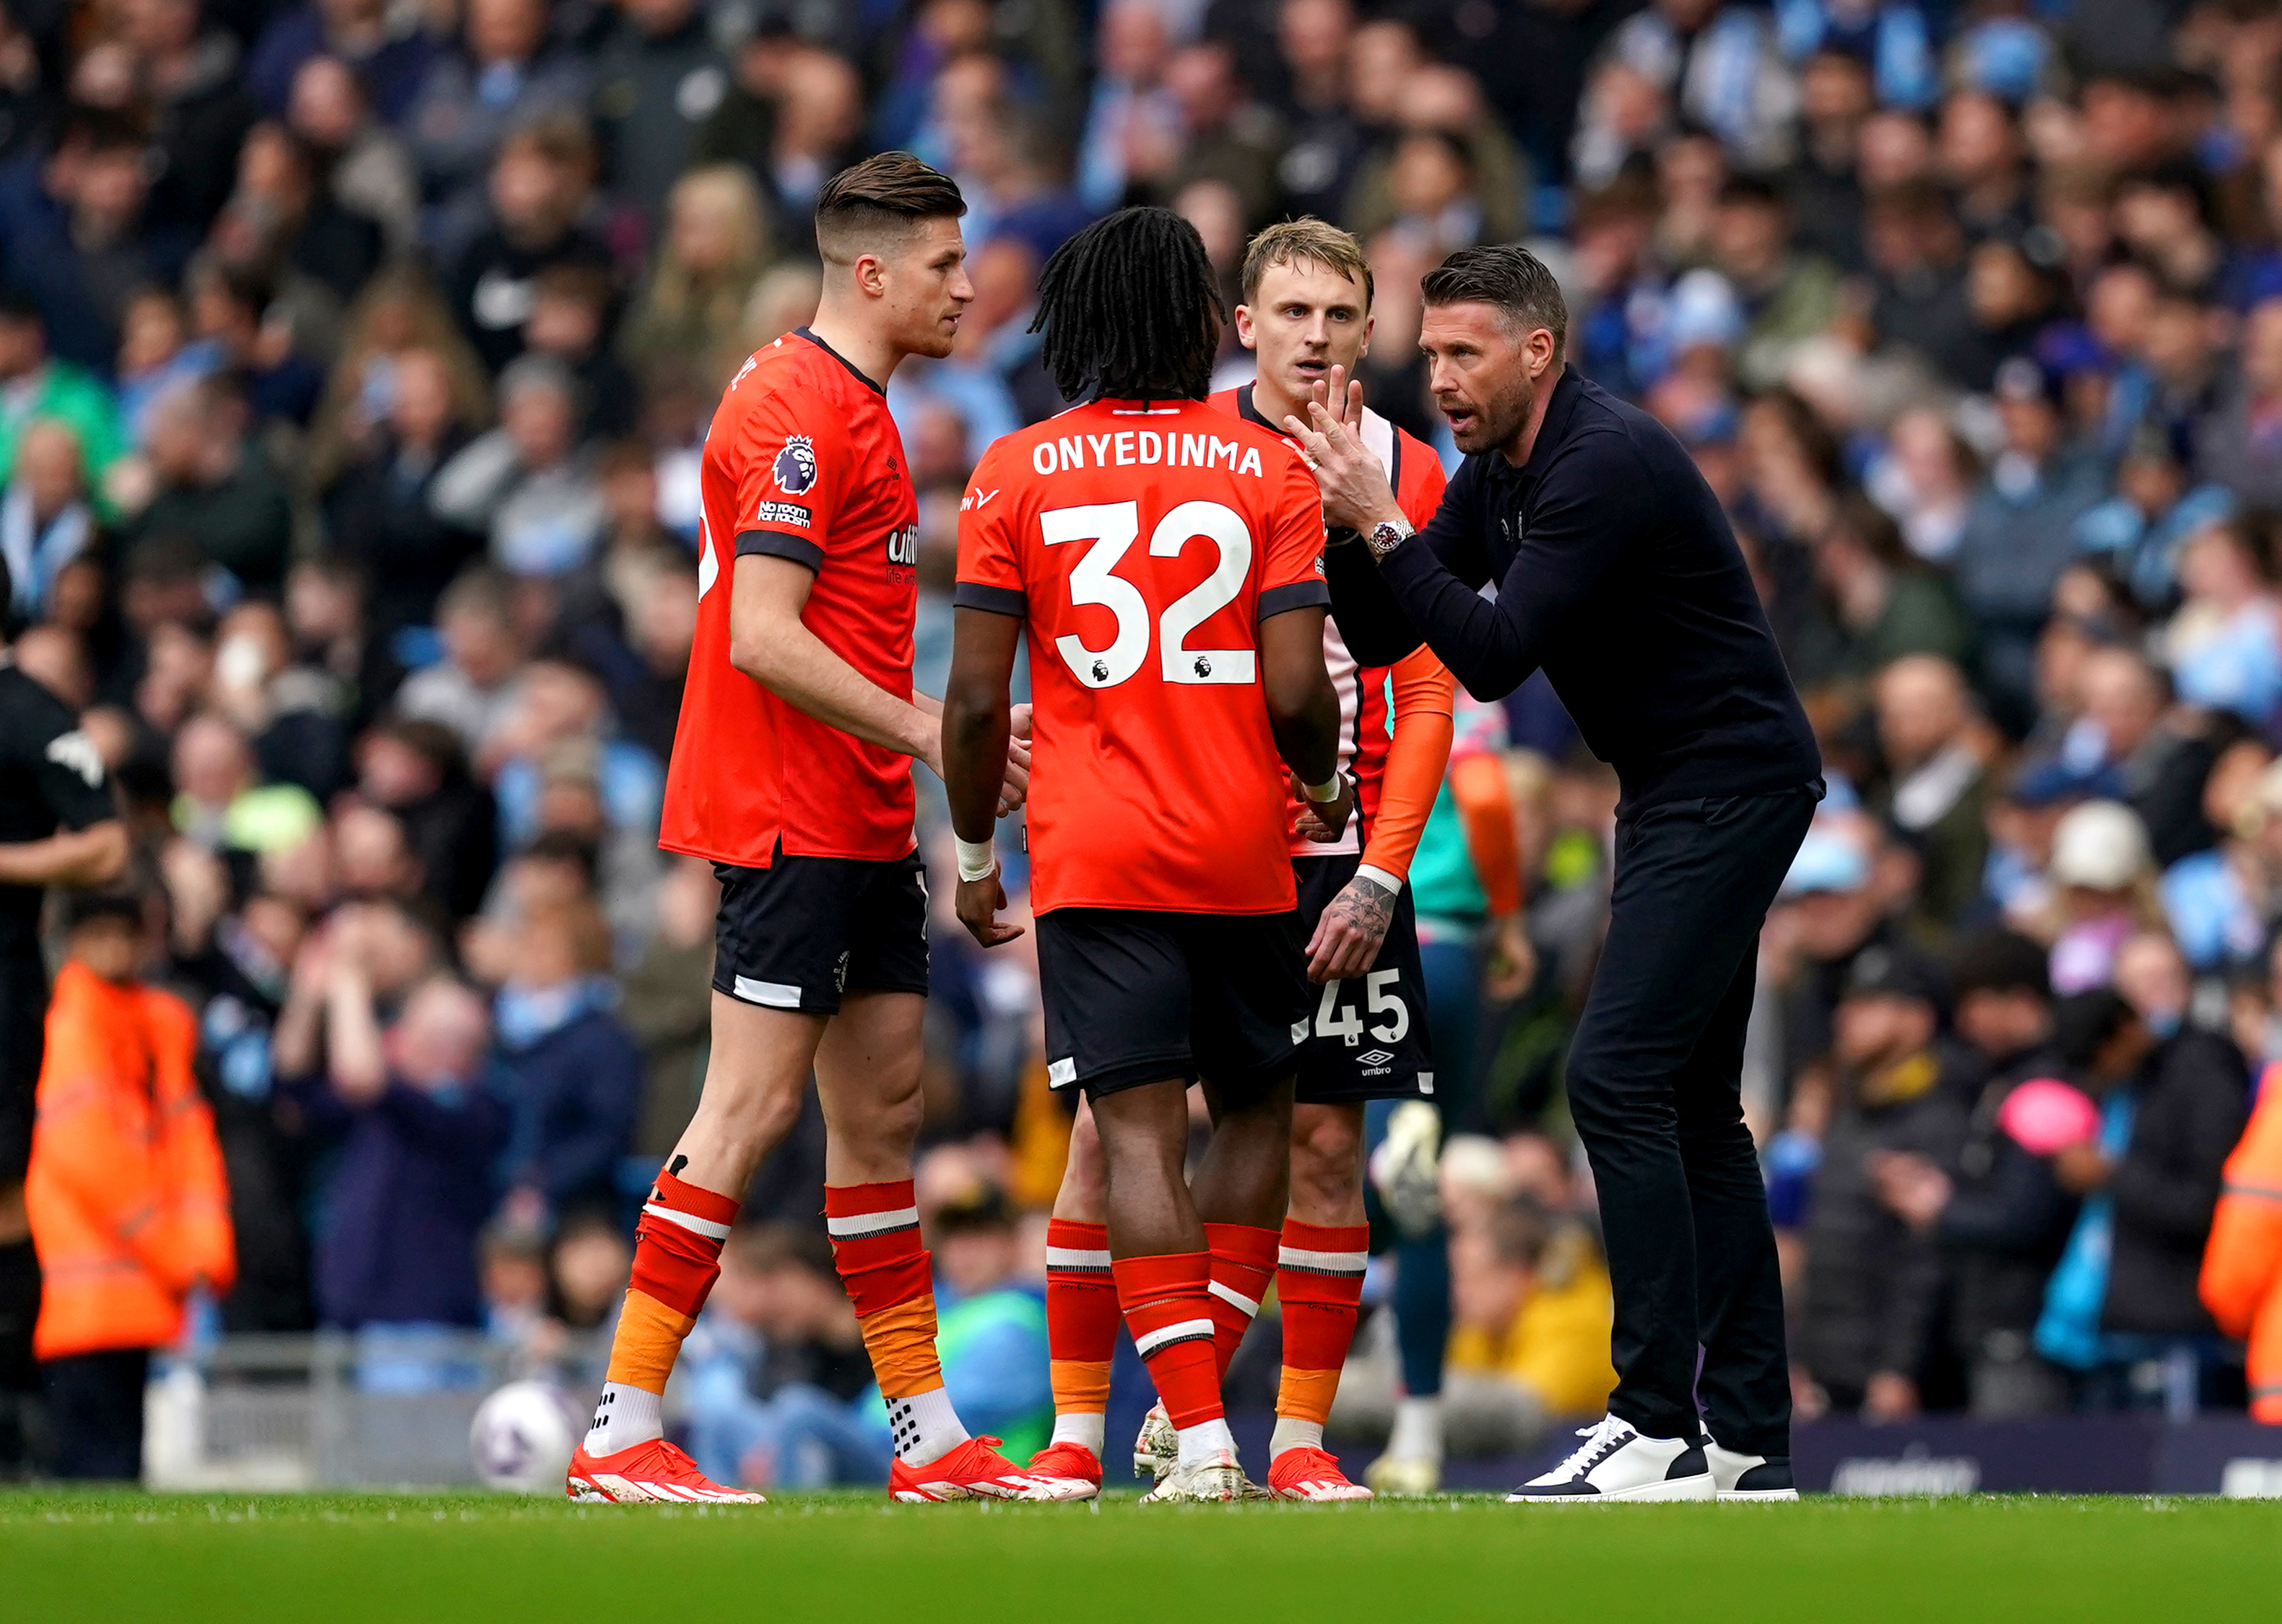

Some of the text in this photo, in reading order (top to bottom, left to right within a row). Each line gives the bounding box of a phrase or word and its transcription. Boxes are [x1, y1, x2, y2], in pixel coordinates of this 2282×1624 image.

[1033, 431, 1262, 477] ONYEDINMA
[758, 511, 810, 529] for racism
[760, 501, 807, 518] No room
[1039, 500, 1256, 688] 32
[1315, 968, 1409, 1046] 45
[1362, 1067, 1391, 1076] umbro
